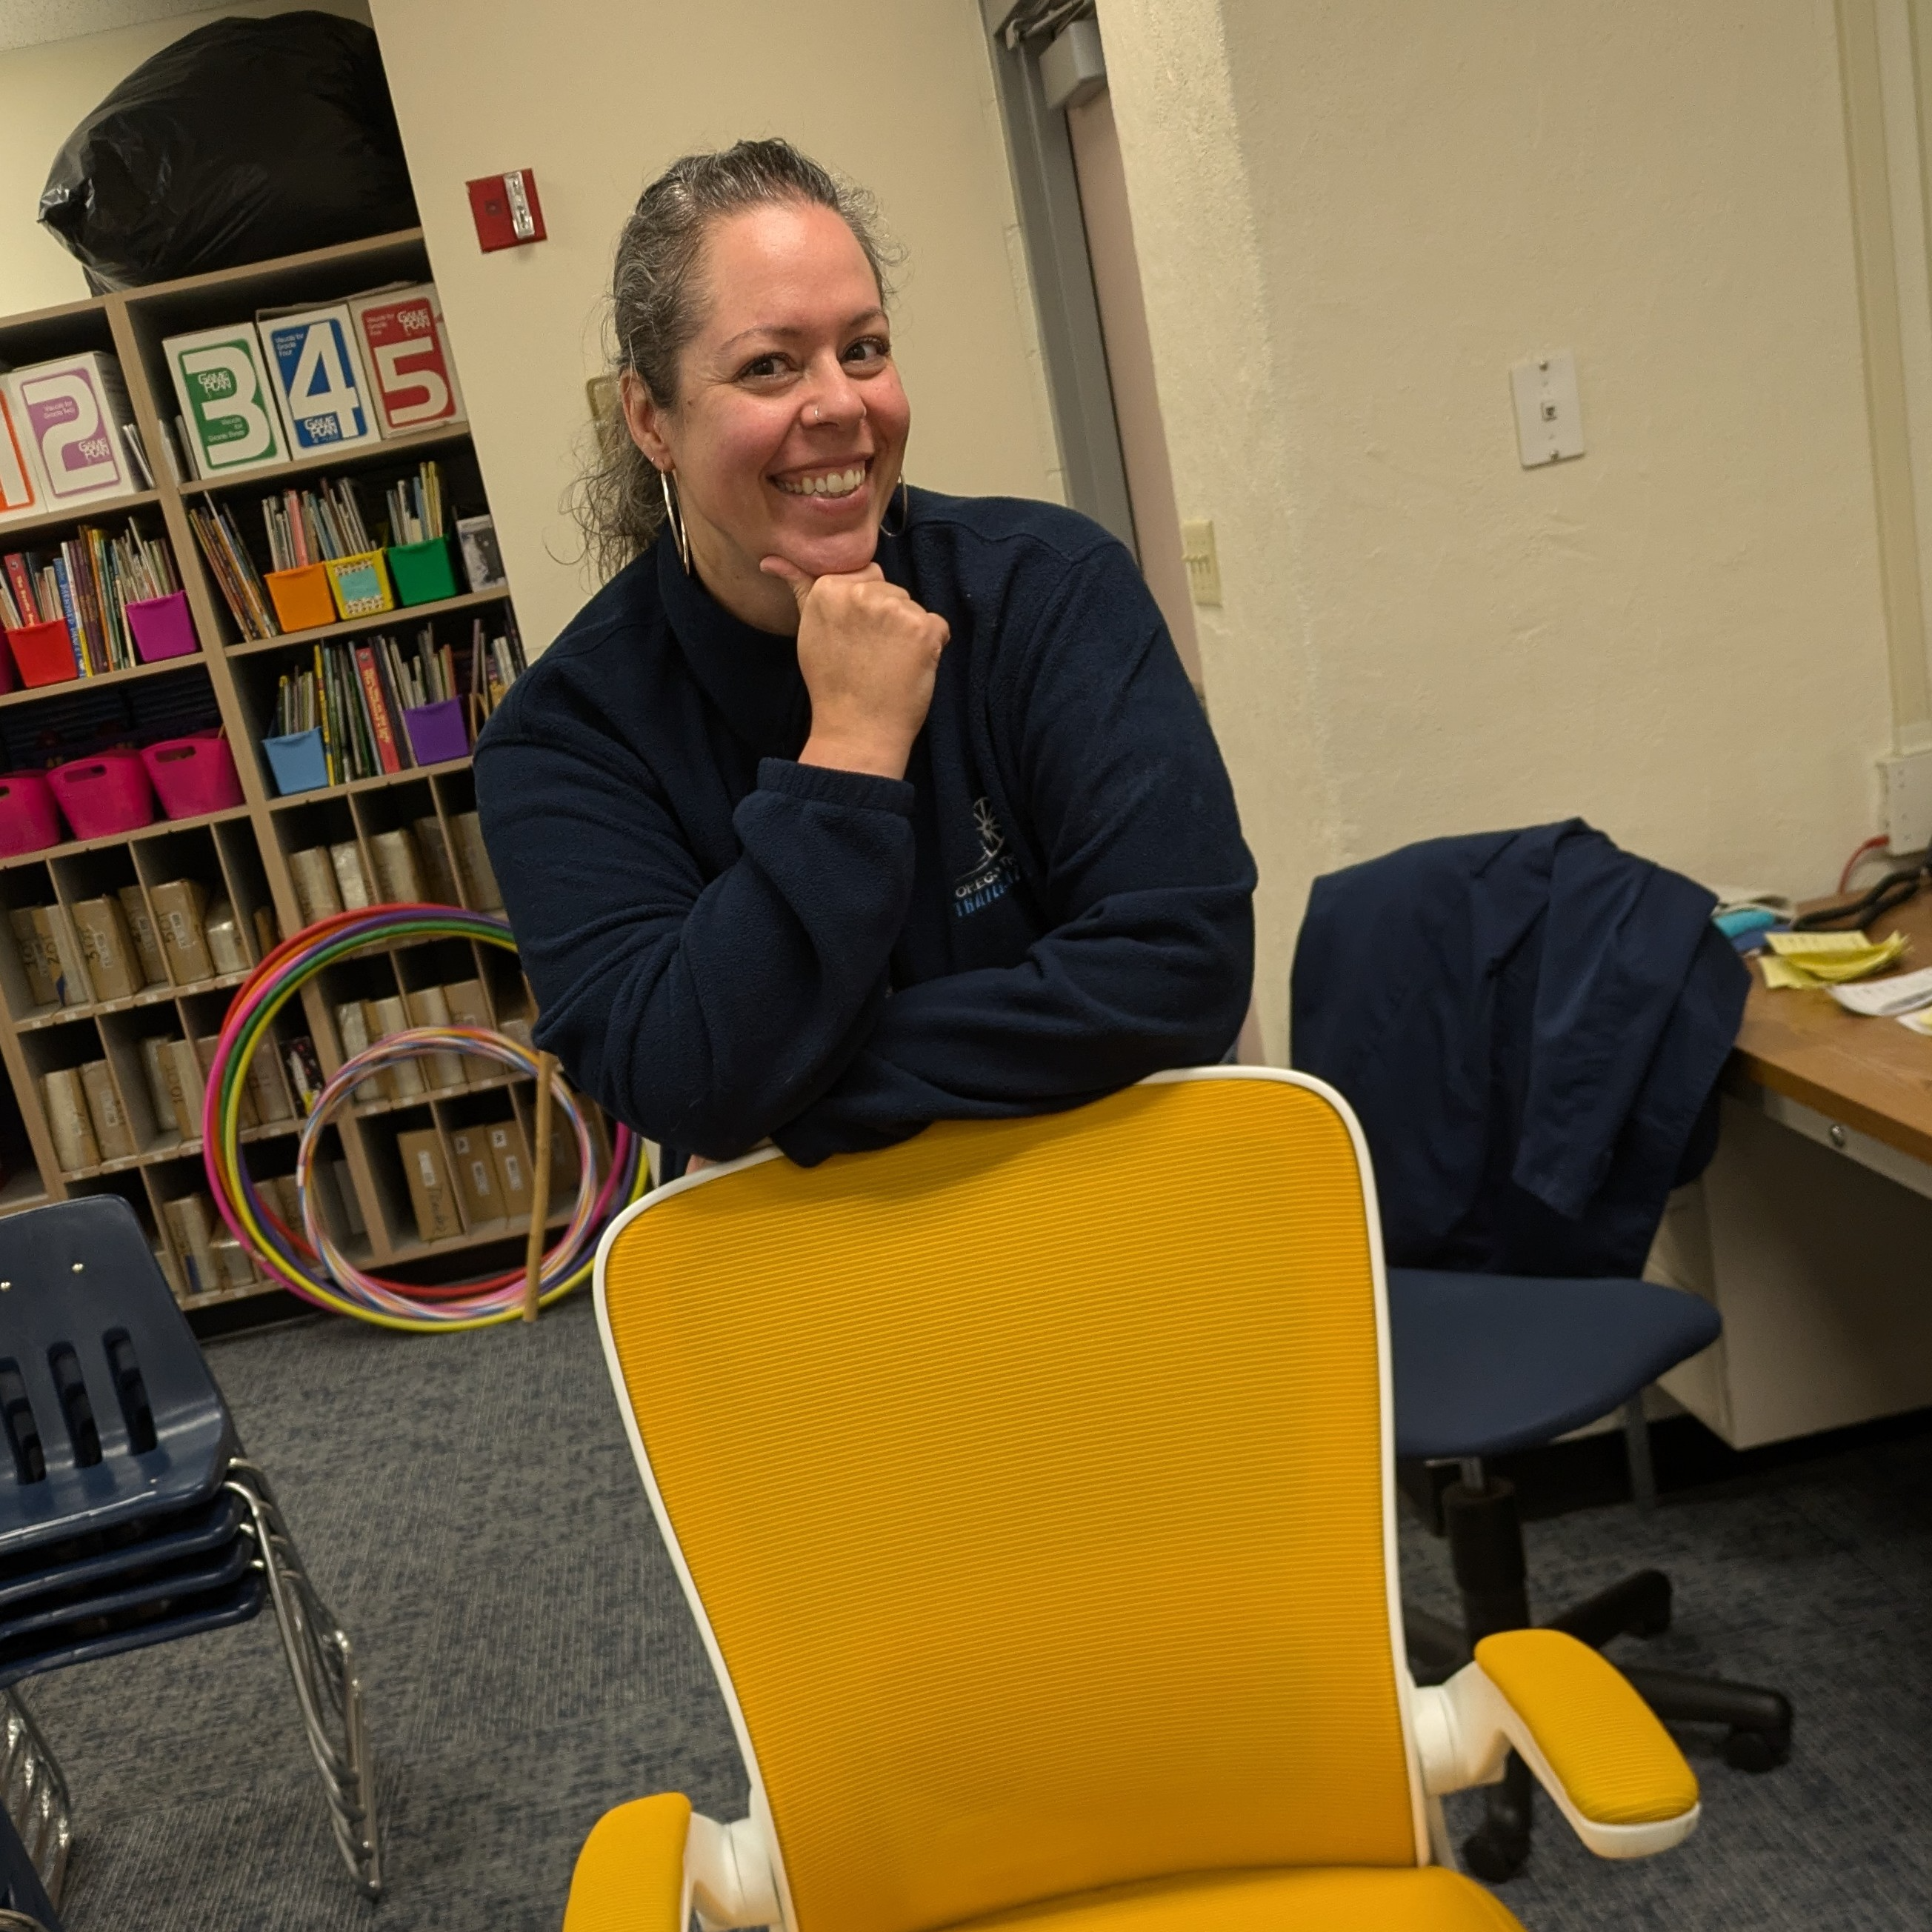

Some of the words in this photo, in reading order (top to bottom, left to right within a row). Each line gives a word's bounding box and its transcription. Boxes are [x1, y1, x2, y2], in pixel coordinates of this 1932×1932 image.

[398, 308, 430, 324] GAME
[404, 318, 431, 332] PLAN
[199, 370, 230, 385] GAME
[288, 322, 360, 439] 4
[373, 336, 448, 424] 5
[204, 379, 232, 394] PLAN
[181, 346, 271, 466] 3
[304, 416, 335, 431] GAME
[310, 423, 339, 439] PLAN
[22, 374, 119, 495] 2
[79, 438, 108, 453] GAME
[84, 444, 110, 459] PLAN
